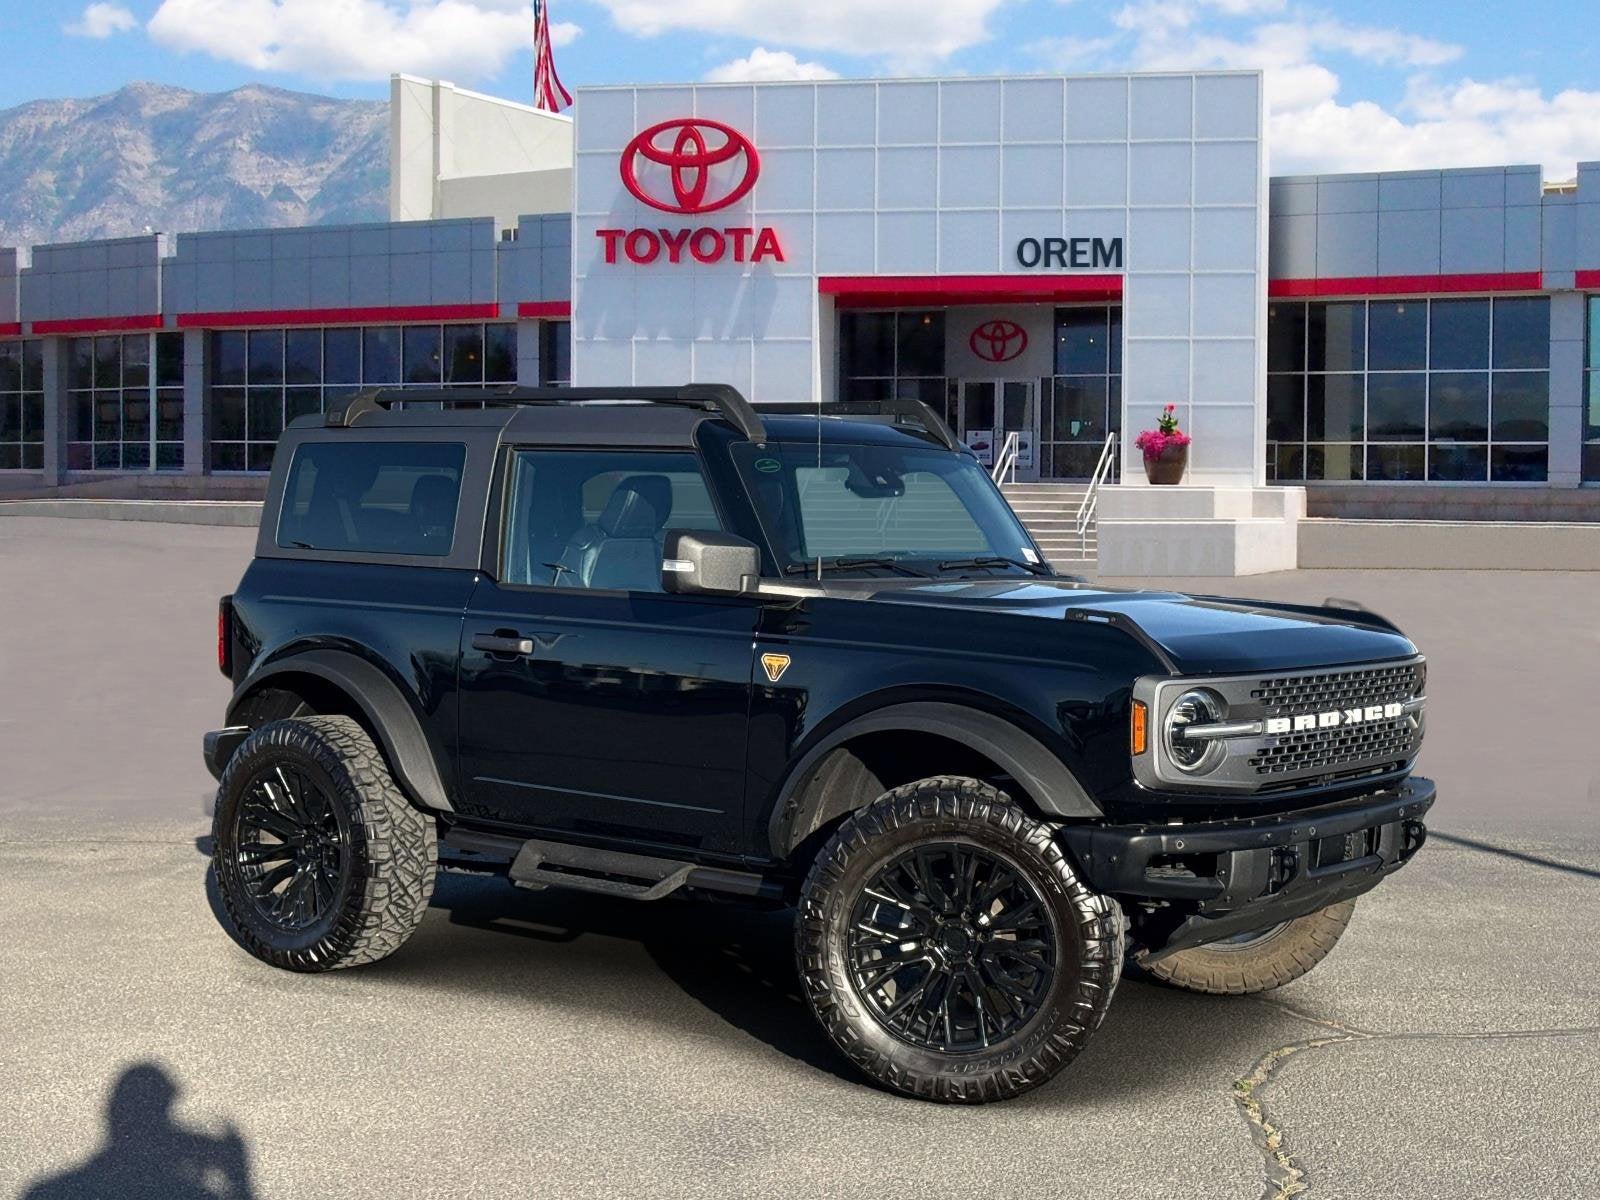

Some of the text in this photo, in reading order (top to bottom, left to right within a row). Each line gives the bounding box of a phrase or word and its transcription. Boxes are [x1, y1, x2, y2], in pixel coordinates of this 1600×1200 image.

[596, 227, 785, 265] TOYOTA
[1016, 237, 1123, 268] OREM
[1267, 703, 1401, 734] BRONCO
